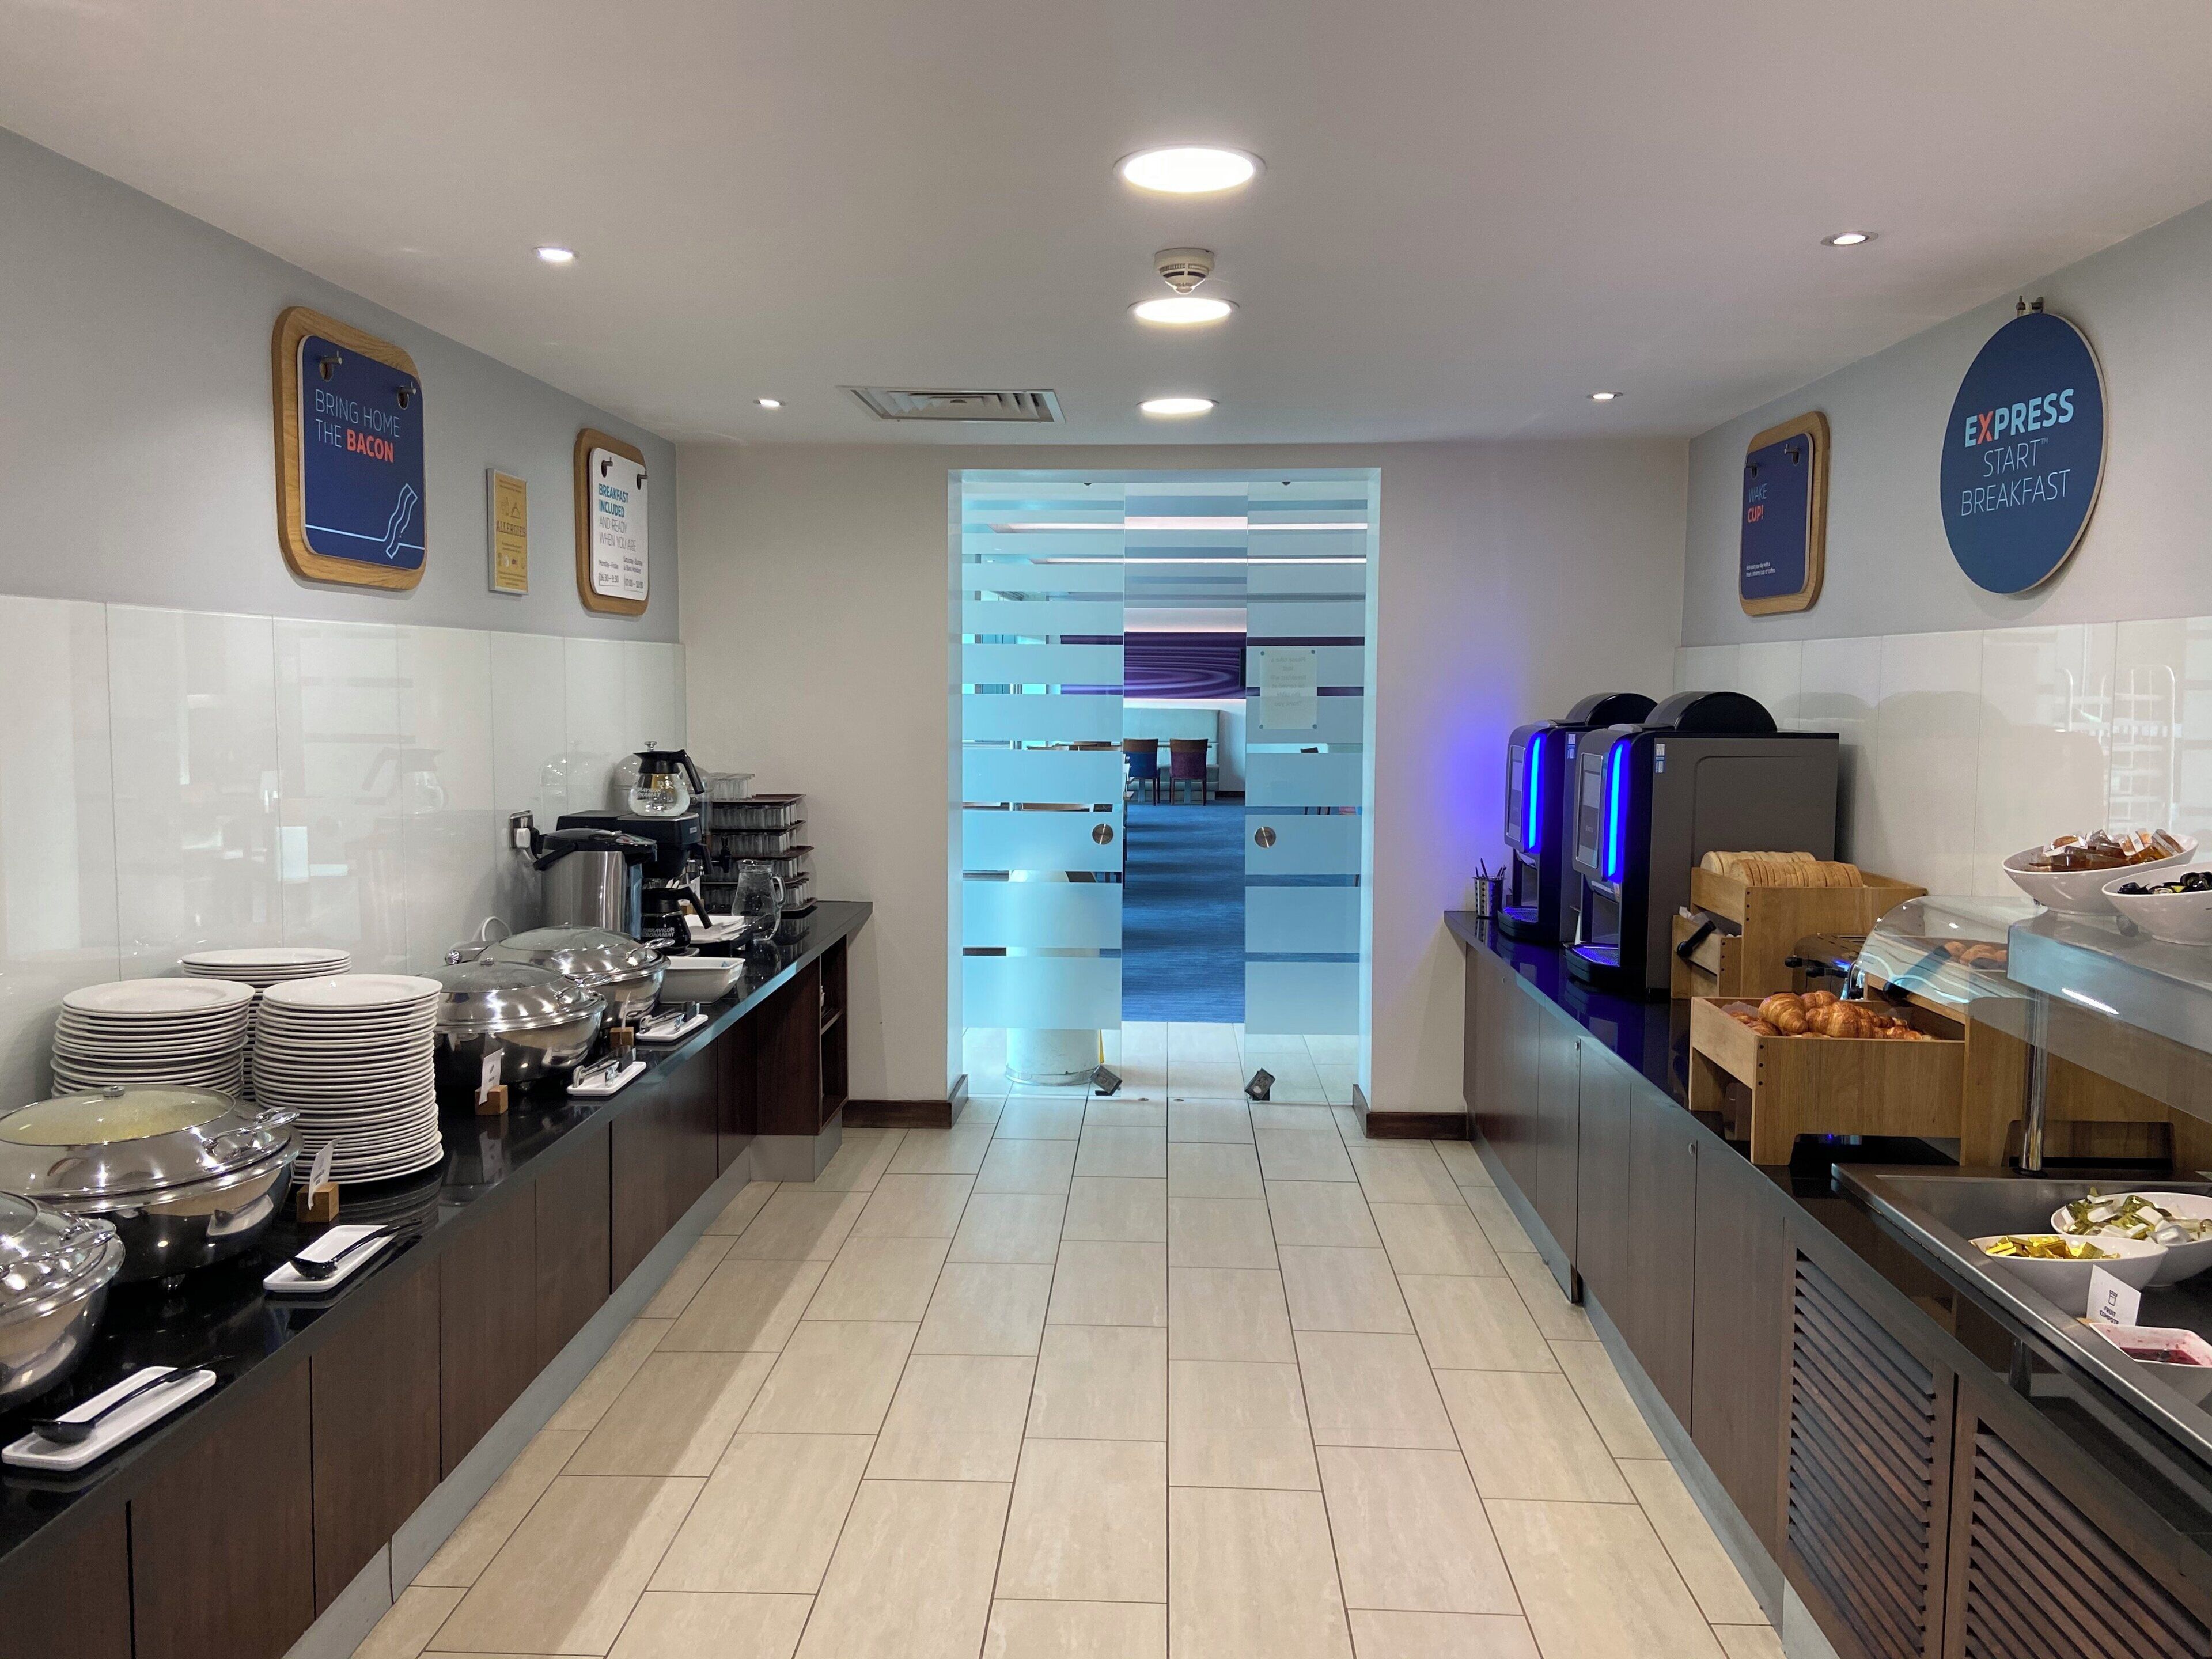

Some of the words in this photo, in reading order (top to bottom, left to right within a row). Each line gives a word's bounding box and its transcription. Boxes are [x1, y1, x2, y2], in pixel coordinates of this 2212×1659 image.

[315, 389, 358, 423] BRING
[363, 406, 400, 438] HOME
[1964, 388, 2075, 448] EXPRESS
[315, 418, 342, 448] THE
[346, 428, 394, 463] BACON
[599, 483, 628, 504] BREAKFAST
[1748, 483, 1768, 503] WAKE
[1961, 469, 2071, 517] BREAKFAST
[599, 499, 625, 518] INCLUDED
[1747, 506, 1764, 524] CUP!
[496, 520, 527, 539] ALLERGIES
[599, 516, 611, 530] AND
[612, 520, 627, 533] READY
[599, 532, 615, 546] WHEN
[616, 536, 626, 549] YOU
[627, 539, 637, 552] ARE
[2104, 1306, 2116, 1317] FRUIT
